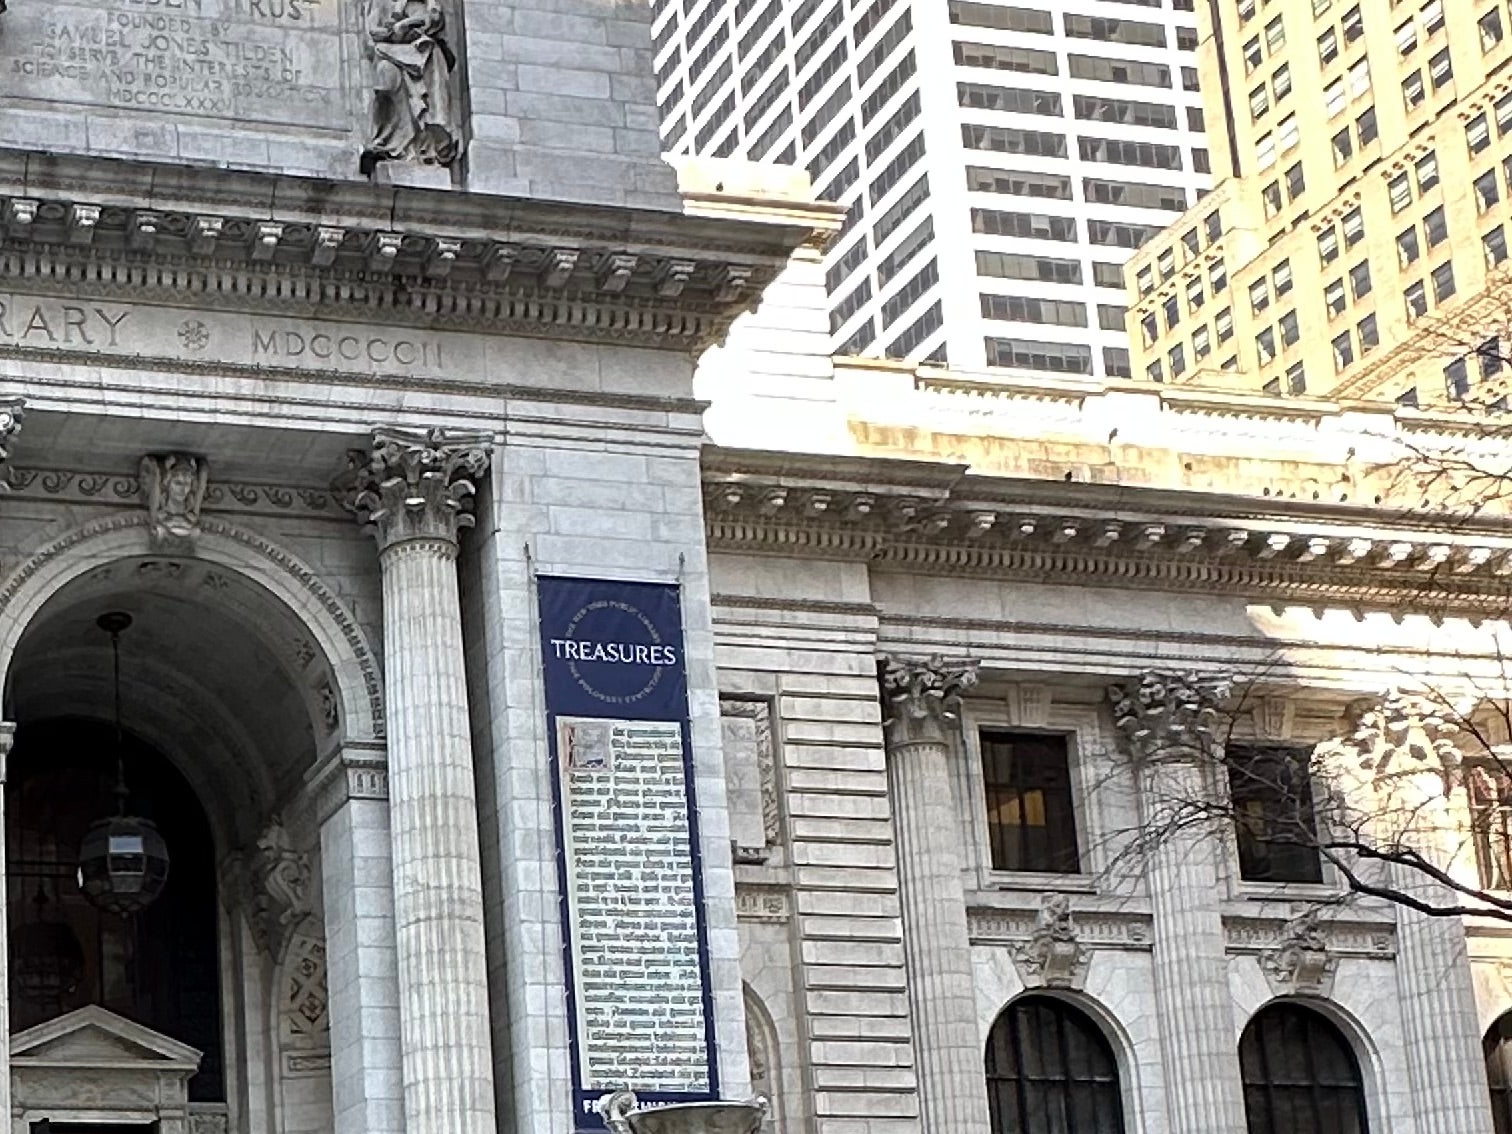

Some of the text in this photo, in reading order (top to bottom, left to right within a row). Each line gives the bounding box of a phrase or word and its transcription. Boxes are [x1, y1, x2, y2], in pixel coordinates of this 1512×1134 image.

[107, 12, 232, 37] FOUNDED BY
[48, 23, 294, 67] SAMUEL JONES TILDEN
[99, 69, 136, 85] AND
[133, 52, 167, 70] THE
[281, 67, 302, 83] OF
[551, 639, 676, 665] TREASURES
